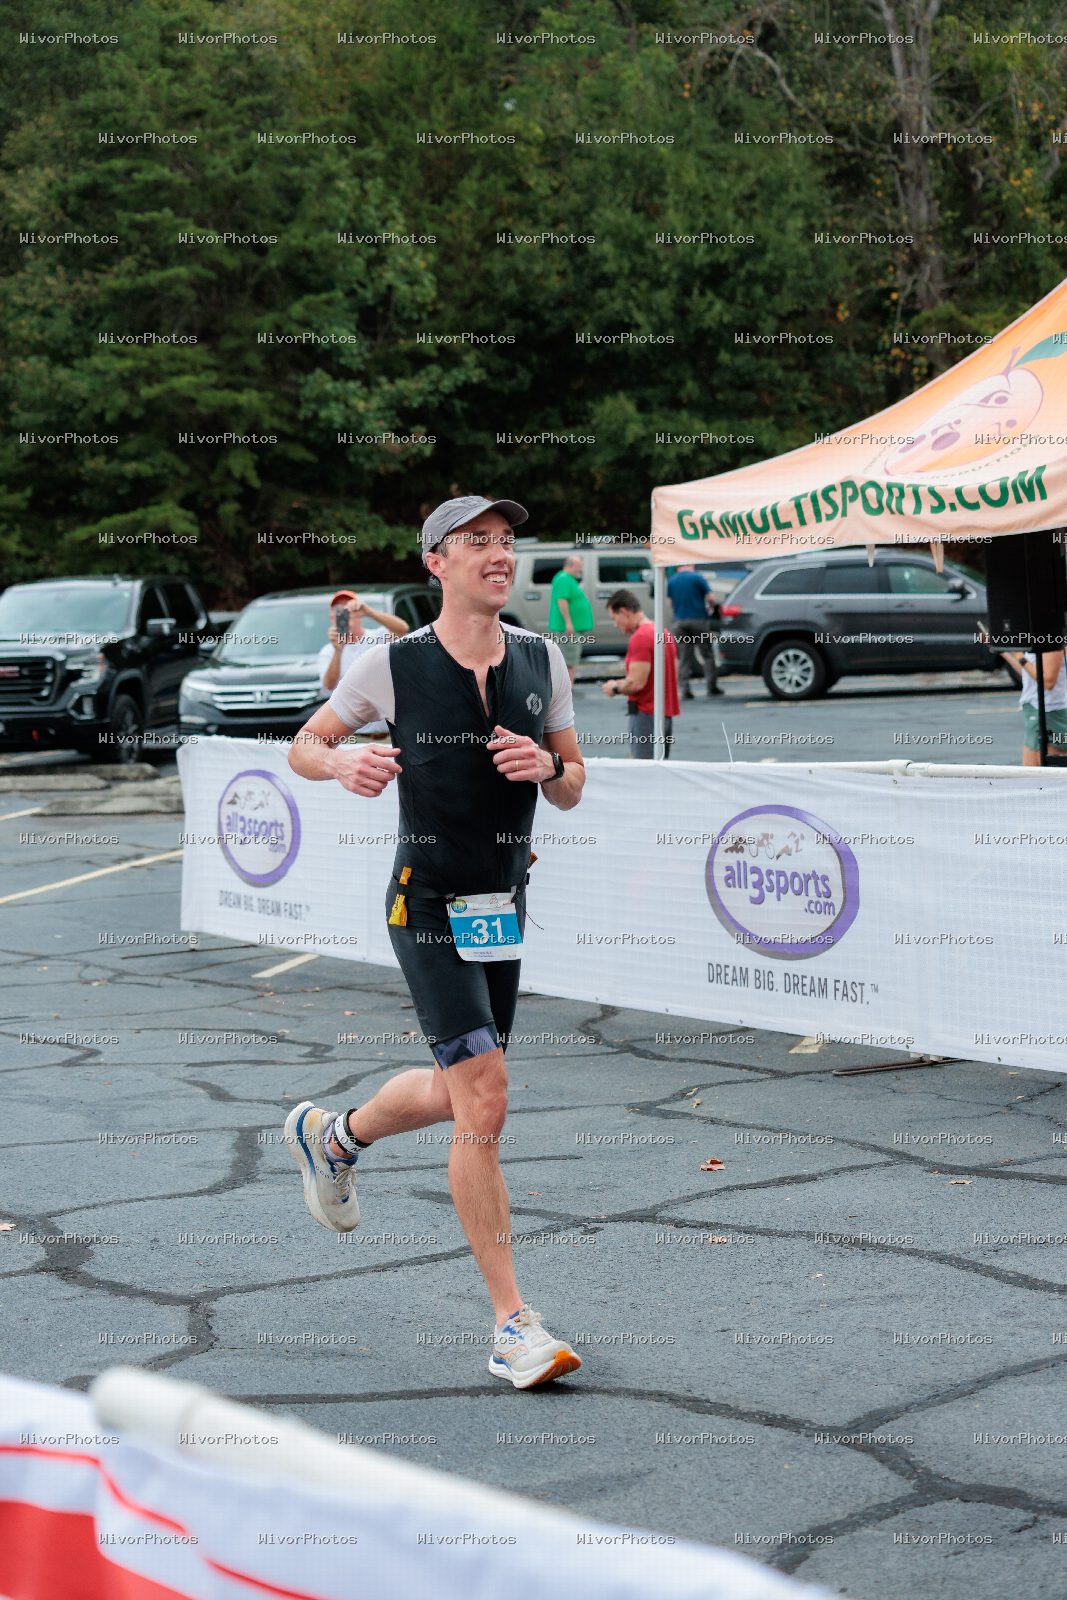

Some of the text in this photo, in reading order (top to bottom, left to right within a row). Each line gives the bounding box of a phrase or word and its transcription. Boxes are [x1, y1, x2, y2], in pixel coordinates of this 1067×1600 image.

[677, 464, 1049, 541] GAMULTISPORTS.COM
[723, 859, 832, 906] all3sports
[804, 899, 836, 917] .com
[471, 917, 503, 945] 31
[707, 962, 749, 988] DREAM
[754, 968, 779, 993] BIG.
[784, 972, 828, 999] DREAM
